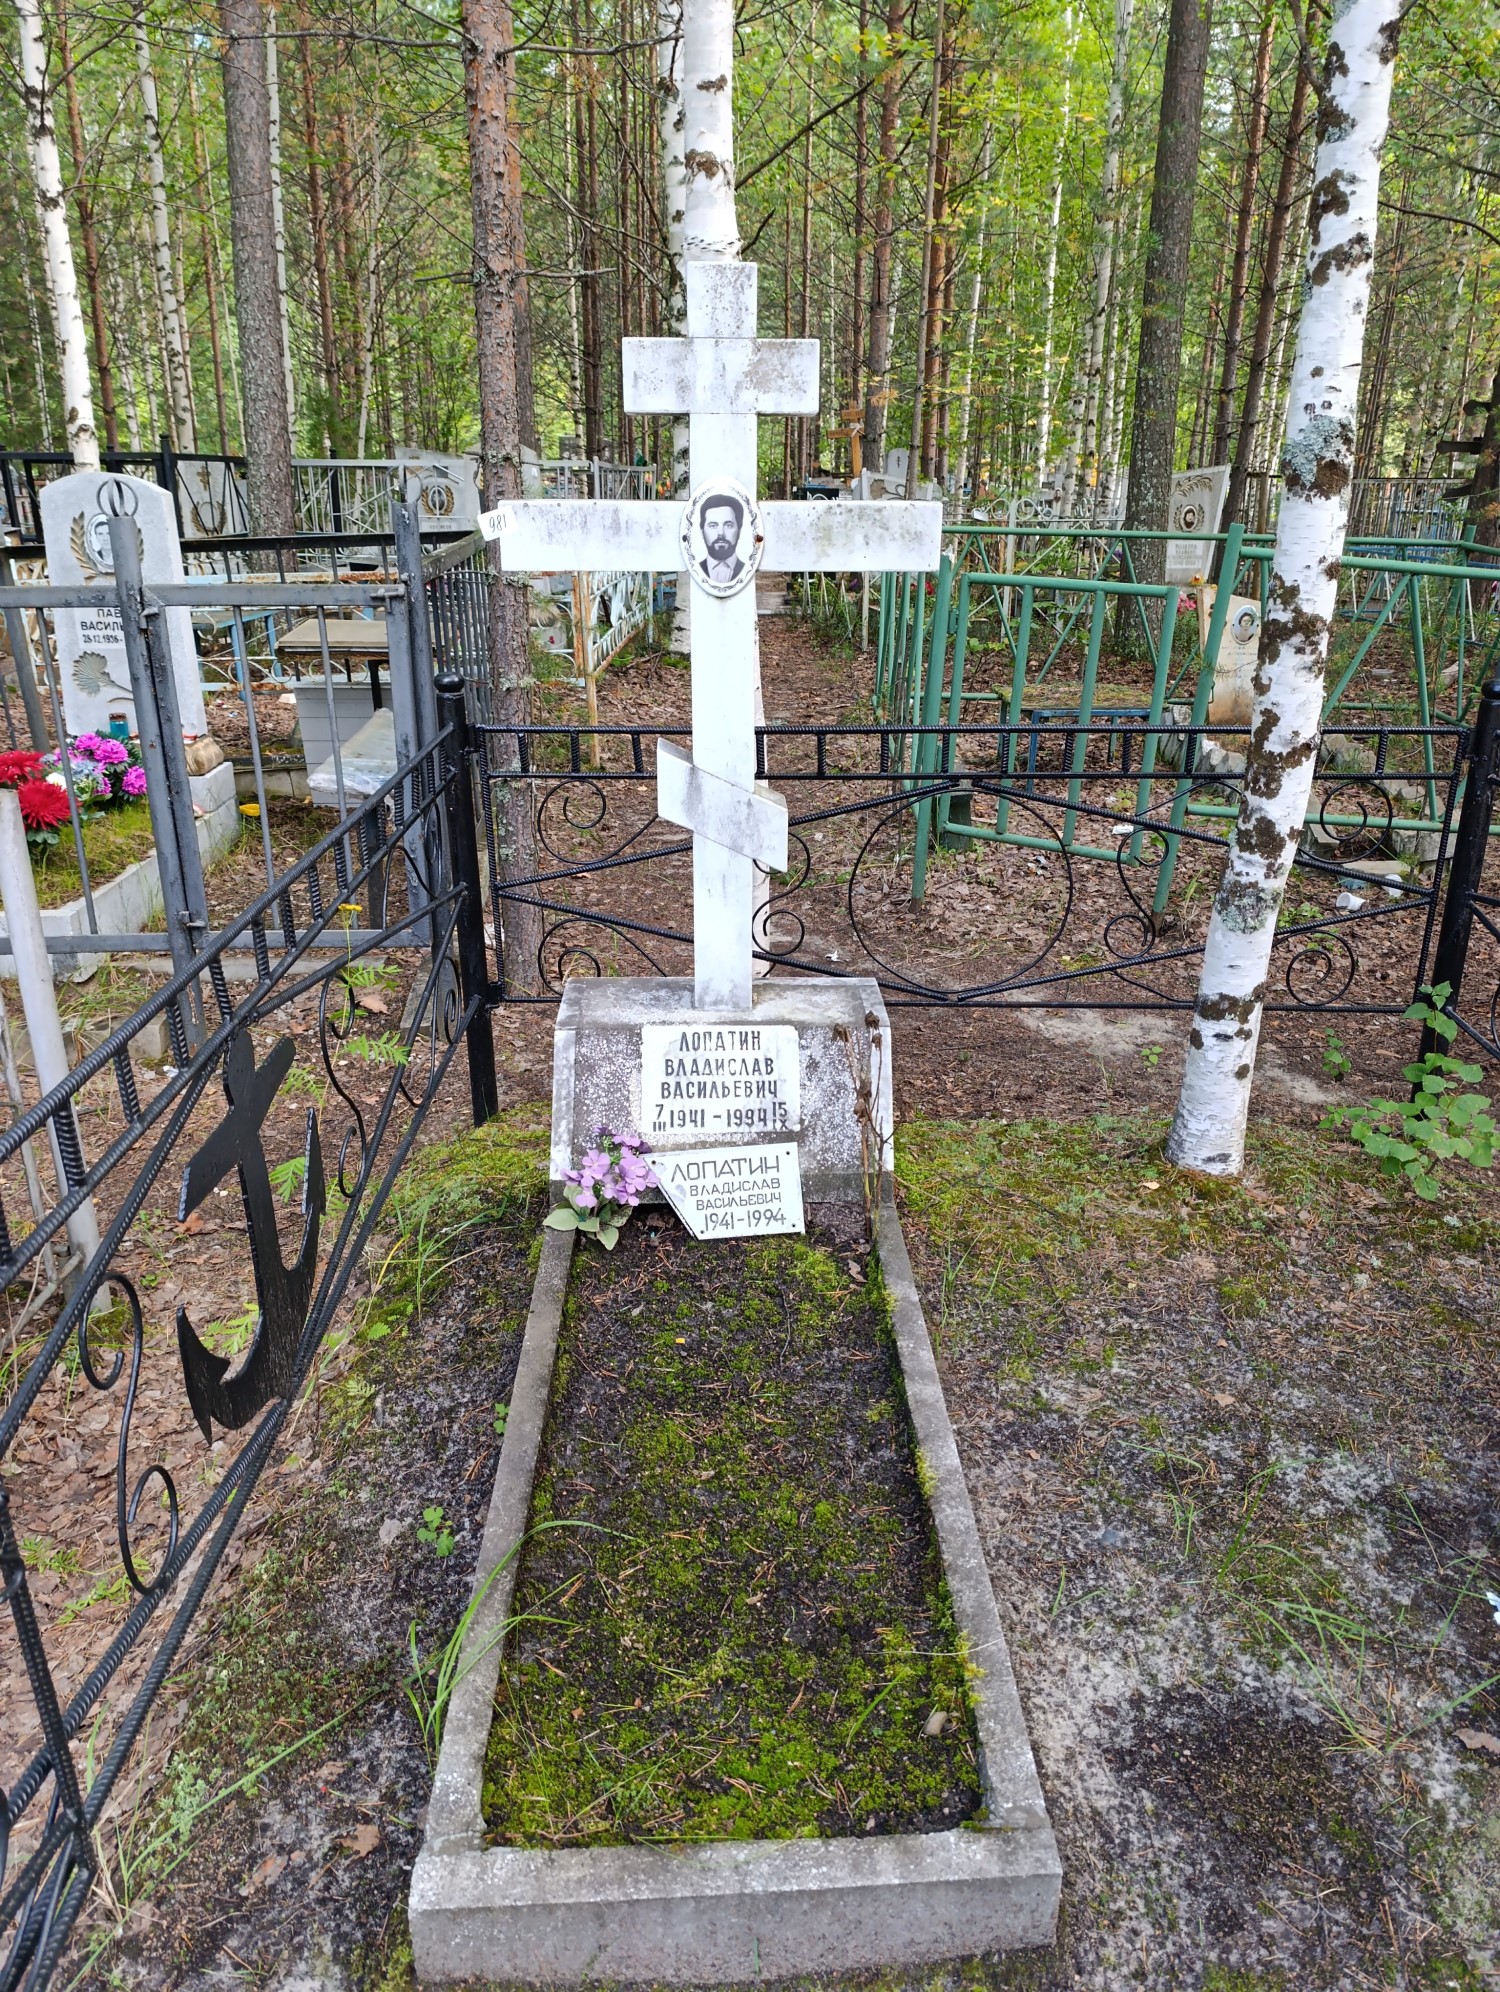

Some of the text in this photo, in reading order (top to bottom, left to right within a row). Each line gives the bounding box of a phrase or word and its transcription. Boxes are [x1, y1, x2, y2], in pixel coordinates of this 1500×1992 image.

[489, 513, 507, 533] 981
[679, 1030, 761, 1052] ЛОПАТИН
[664, 1057, 774, 1077] ВЛАДИСЛАВ
[661, 1079, 778, 1100] ВАСИЛЬЕВИЧ
[655, 1103, 664, 1120] 7
[772, 1101, 788, 1118] 15
[671, 1155, 780, 1183] ЛОПАТИН
[689, 1177, 781, 1197] ВЛАДИСЛАВ
[696, 1192, 782, 1211] ВАСИЛЬЕВИЧ
[704, 1207, 787, 1231] 1941-1994
